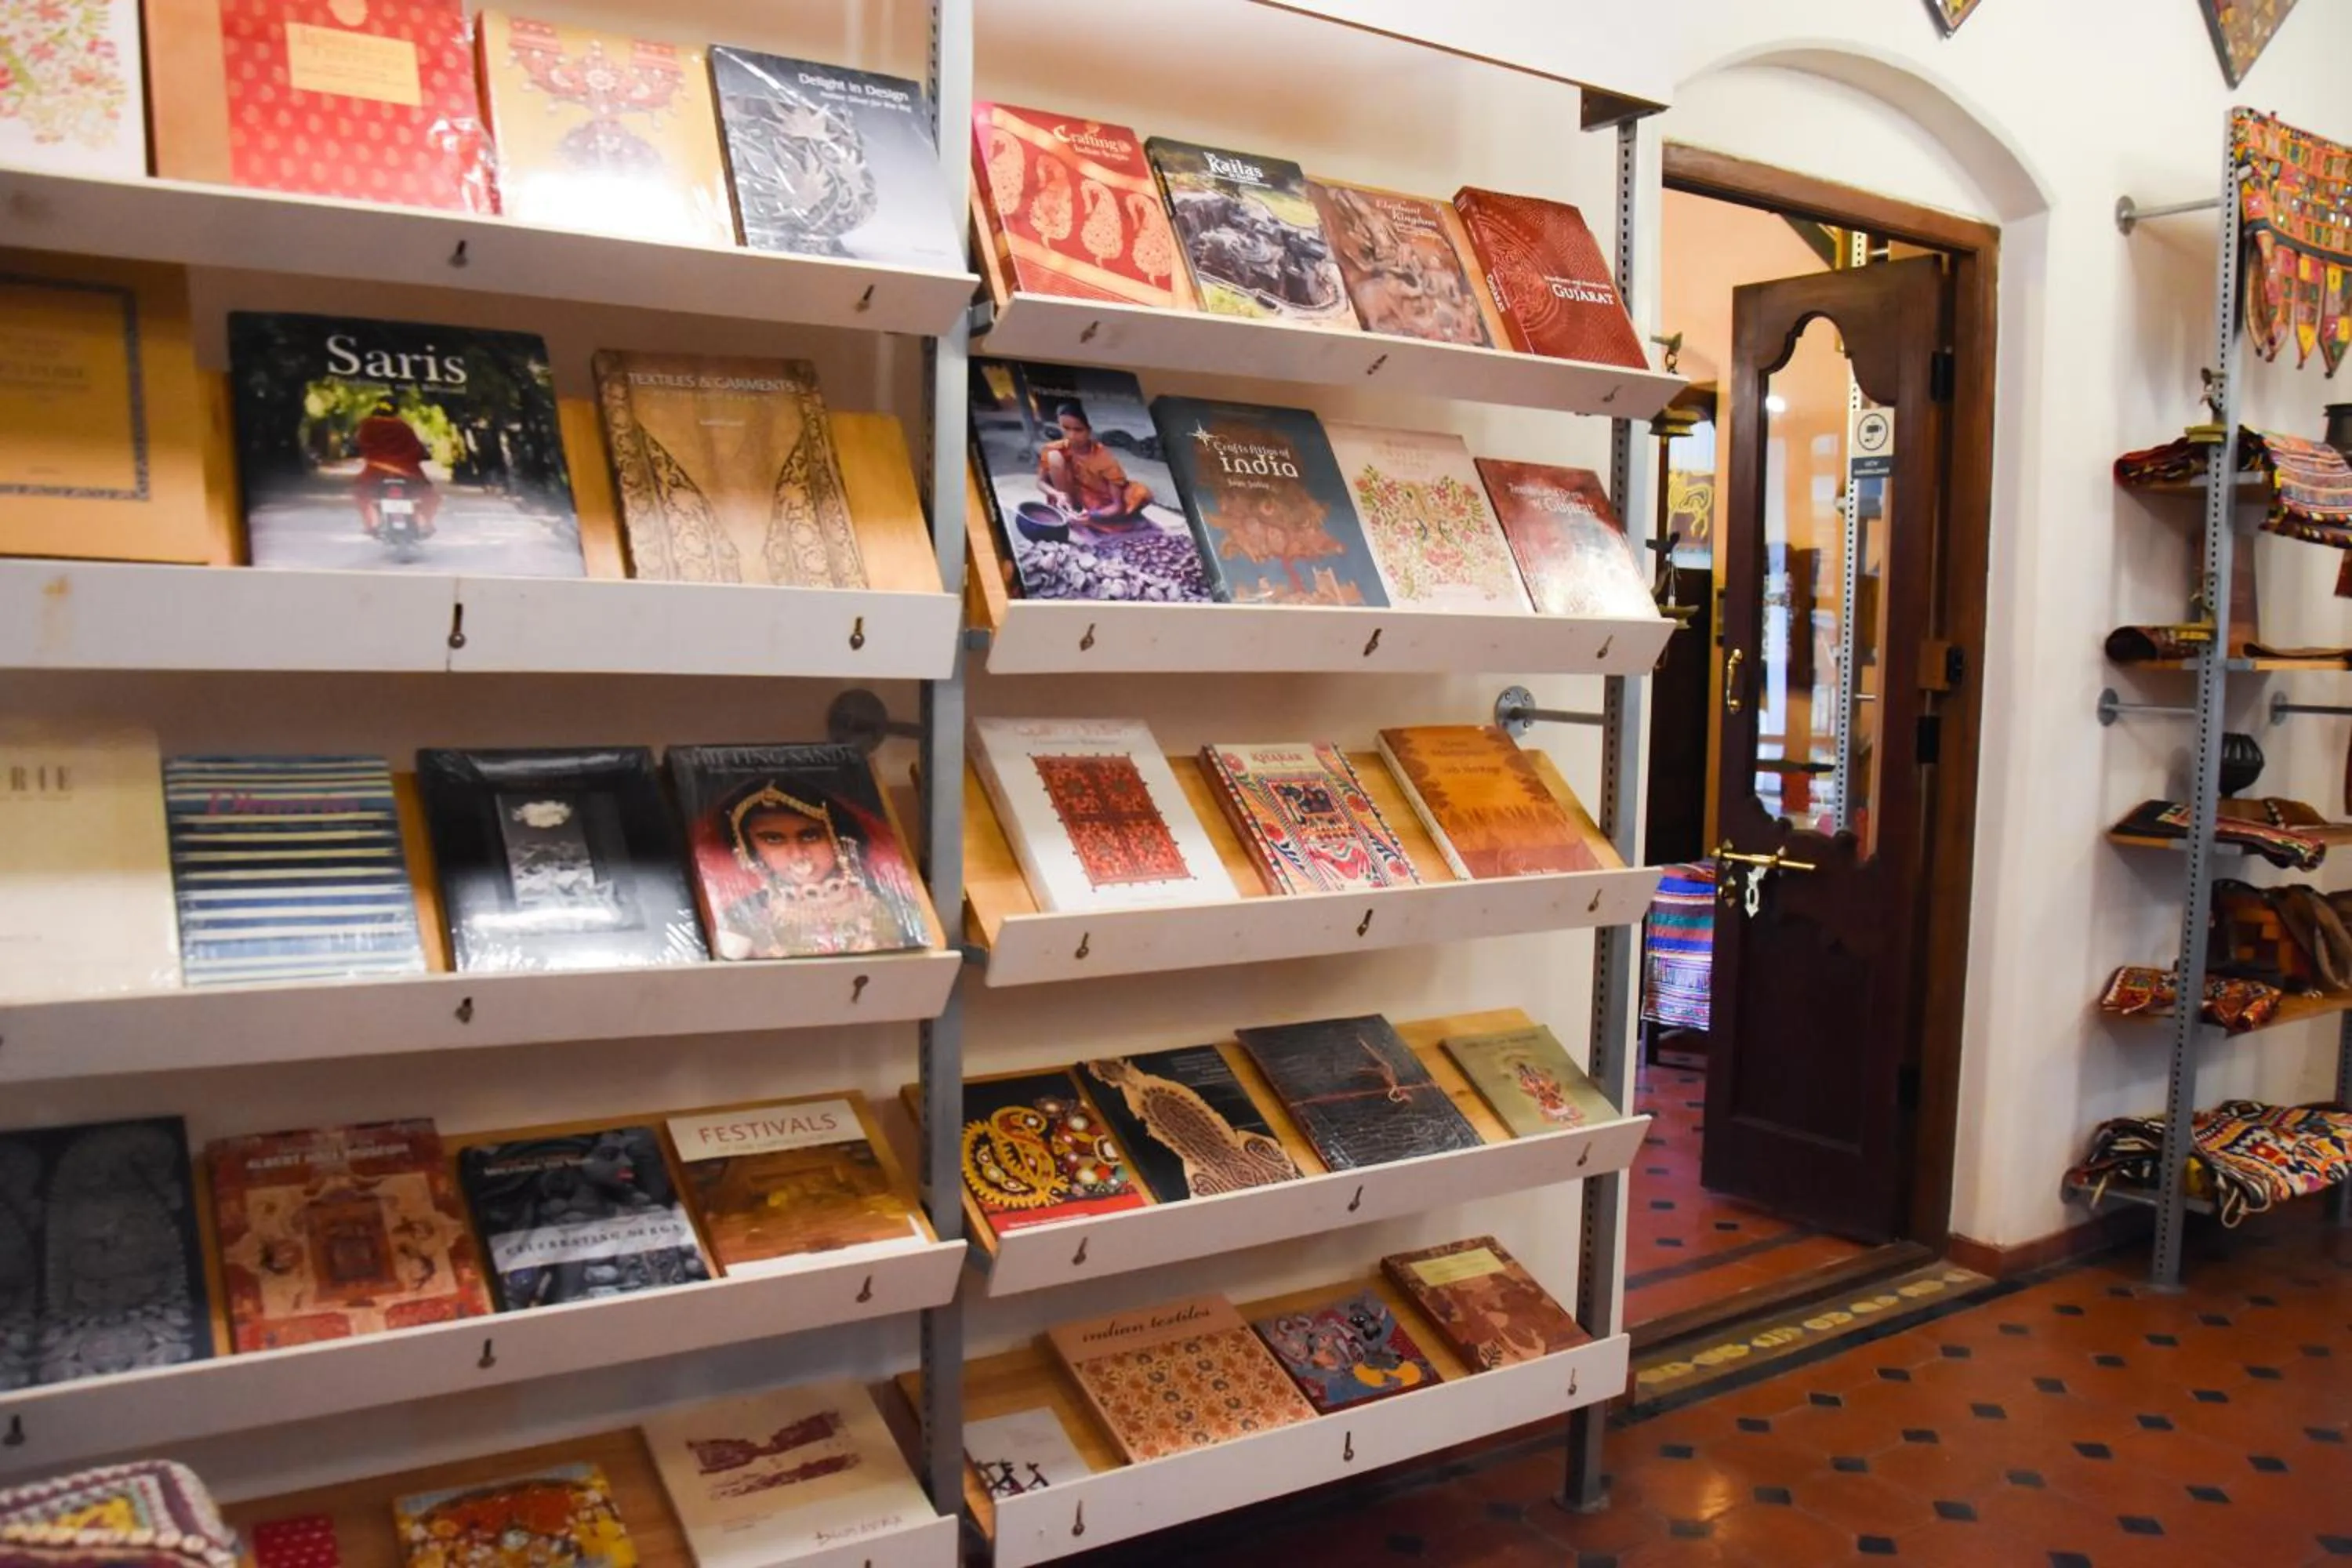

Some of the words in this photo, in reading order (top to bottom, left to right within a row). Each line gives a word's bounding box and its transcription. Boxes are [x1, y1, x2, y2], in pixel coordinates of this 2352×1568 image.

[798, 72, 847, 92] Delight
[849, 81, 862, 94] in
[865, 84, 909, 103] Design
[1207, 156, 1264, 178] Kailas
[1552, 283, 1614, 305] GUJARAT
[326, 334, 467, 383] Saris
[628, 372, 695, 388] TEXTILES
[714, 376, 796, 392] GARMENTS
[1218, 451, 1299, 478] india
[698, 1112, 837, 1144] FESTIVALS
[1083, 1321, 1144, 1342] indian
[1150, 1305, 1210, 1328] textiles
